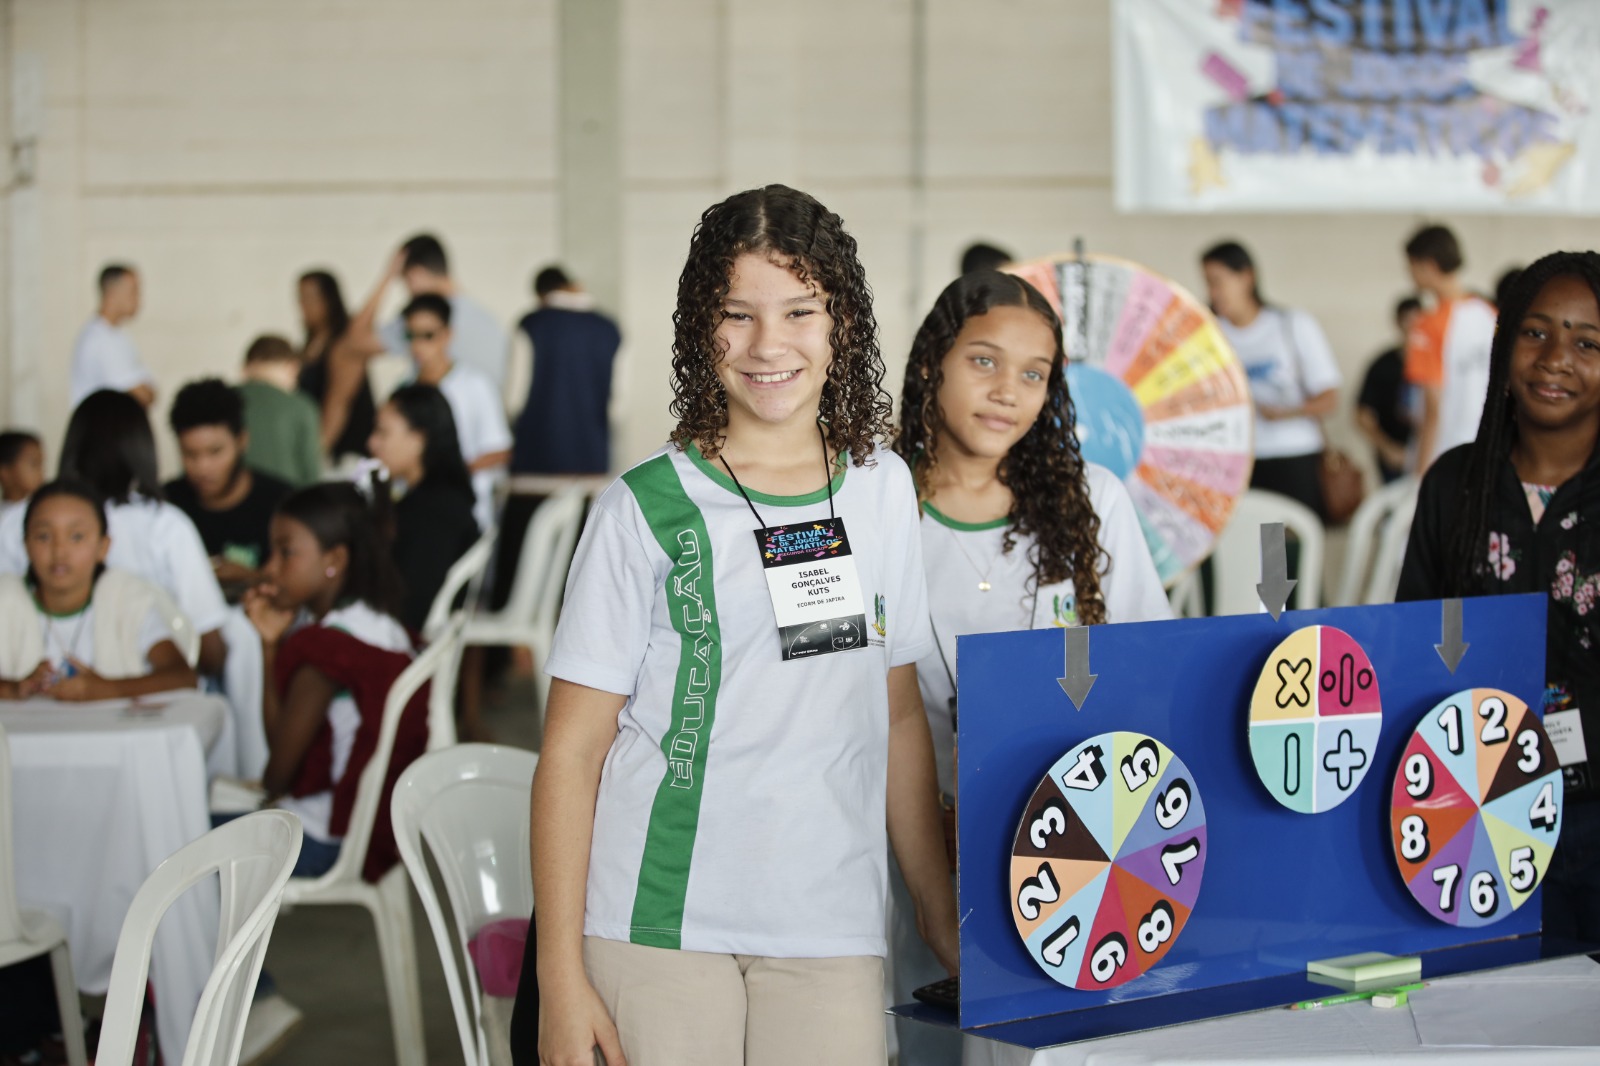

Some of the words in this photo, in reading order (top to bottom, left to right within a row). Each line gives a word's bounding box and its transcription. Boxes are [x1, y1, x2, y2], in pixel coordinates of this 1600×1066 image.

[771, 528, 829, 543] FESTIVAL
[793, 536, 820, 546] JOGOS
[791, 575, 841, 589] GONÇALVES
[798, 567, 830, 579] ISABEL
[807, 586, 830, 596] KUTS
[669, 529, 714, 789] EDUCAÇÃO
[1438, 704, 1464, 755] 1
[1478, 696, 1509, 746] 2
[1062, 745, 1107, 791] 4
[1120, 739, 1160, 792] 5
[1517, 729, 1544, 774] 3
[1404, 753, 1434, 800] 9
[1029, 797, 1067, 850] 3
[1529, 782, 1558, 832] 4
[1161, 837, 1201, 886] 7
[1400, 814, 1430, 863] 8
[1017, 861, 1060, 922] 2
[1432, 863, 1462, 913] 7
[1510, 846, 1538, 893] 5
[1469, 871, 1499, 918] 6
[1041, 915, 1080, 968] 1
[1137, 899, 1175, 953] 8
